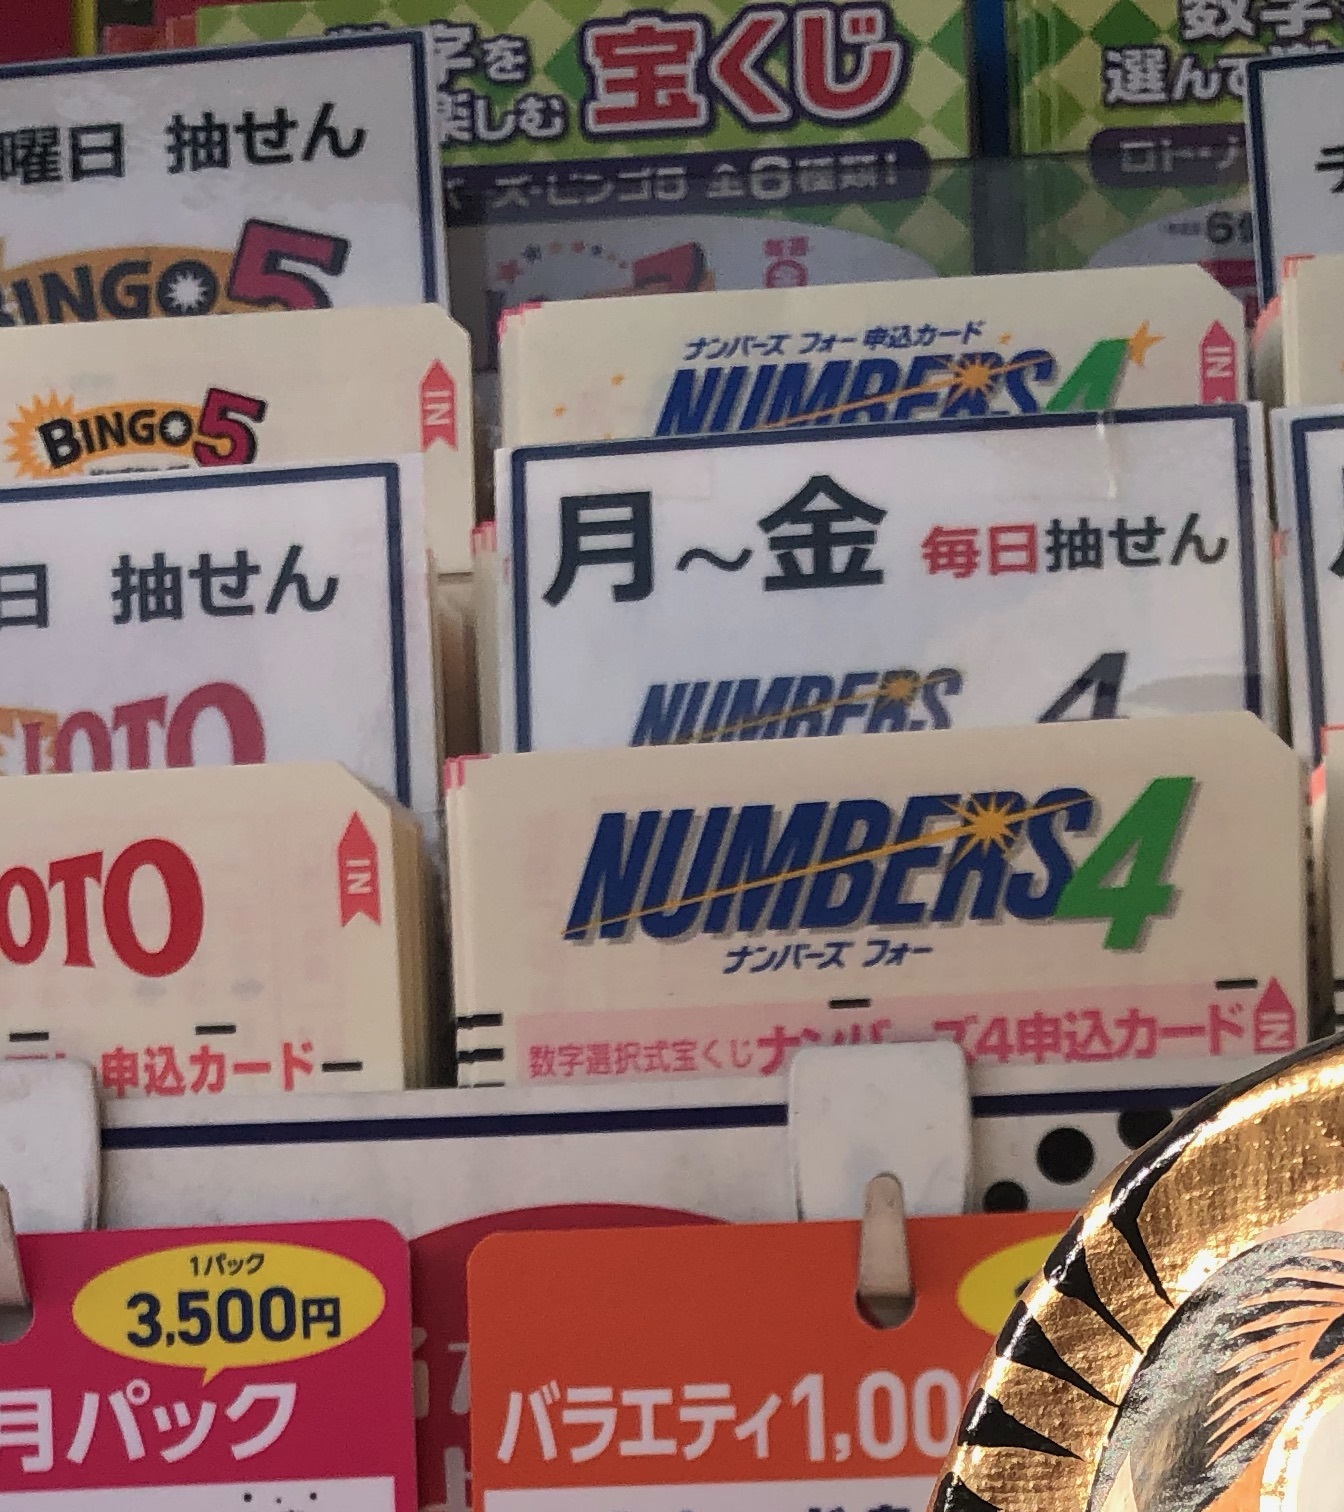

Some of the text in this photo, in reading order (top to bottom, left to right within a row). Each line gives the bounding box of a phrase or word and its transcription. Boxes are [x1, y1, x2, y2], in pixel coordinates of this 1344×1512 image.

[584, 9, 911, 134] 宝くじ
[167, 103, 366, 175] 抽せん
[863, 321, 985, 352] 申込カード
[38, 386, 267, 469] BINGO 5
[921, 514, 1229, 579] 毎日抽せん
[111, 545, 339, 626] 抽せん
[562, 775, 1199, 951] NUMBERS 4
[724, 939, 934, 974] ナンバーズ フォー
[102, 1042, 316, 1096] 申込カード
[189, 1252, 265, 1278] 1パック
[126, 1286, 342, 1348] 3,500円
[497, 1366, 976, 1464] バラエティ1,00
